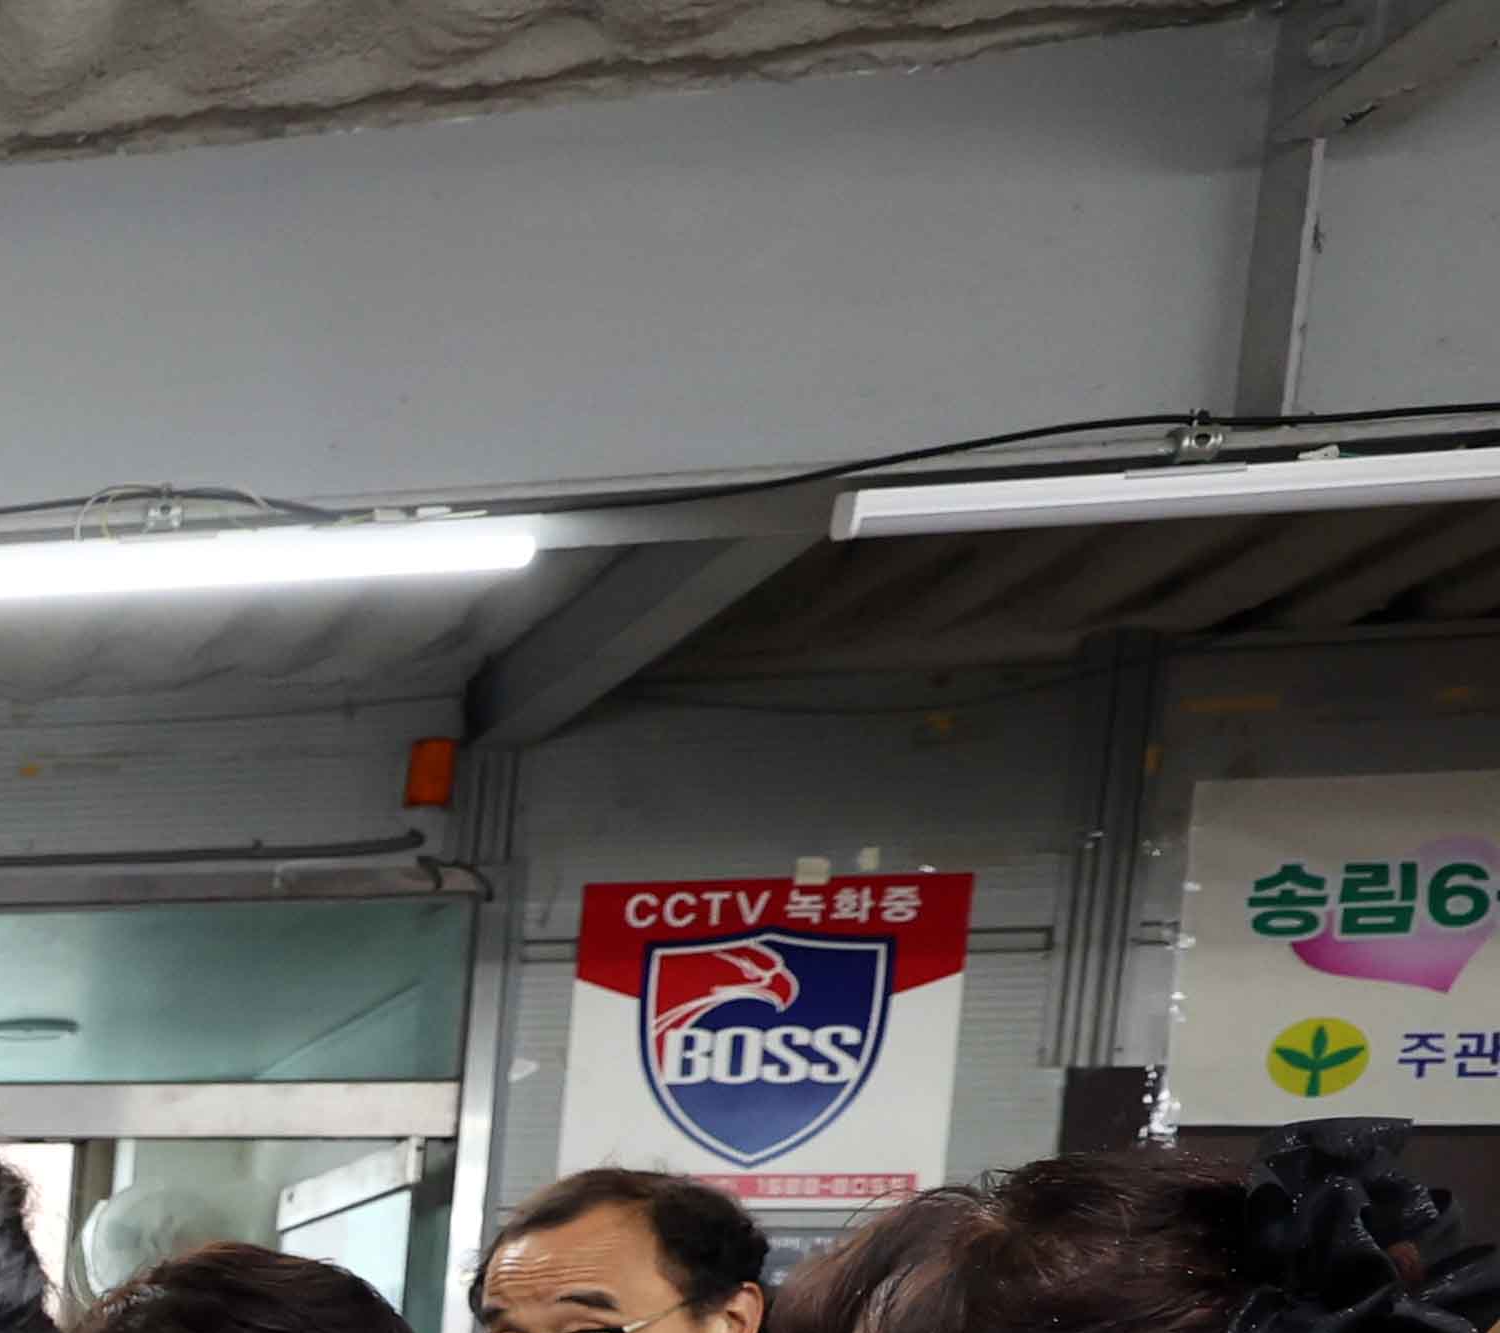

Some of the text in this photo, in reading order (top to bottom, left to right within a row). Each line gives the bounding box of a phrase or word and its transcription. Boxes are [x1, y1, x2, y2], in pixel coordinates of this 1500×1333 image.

[624, 885, 923, 928] CCTV 녹화중
[1247, 862, 1500, 938] 송림6
[664, 1025, 863, 1085] BOSS
